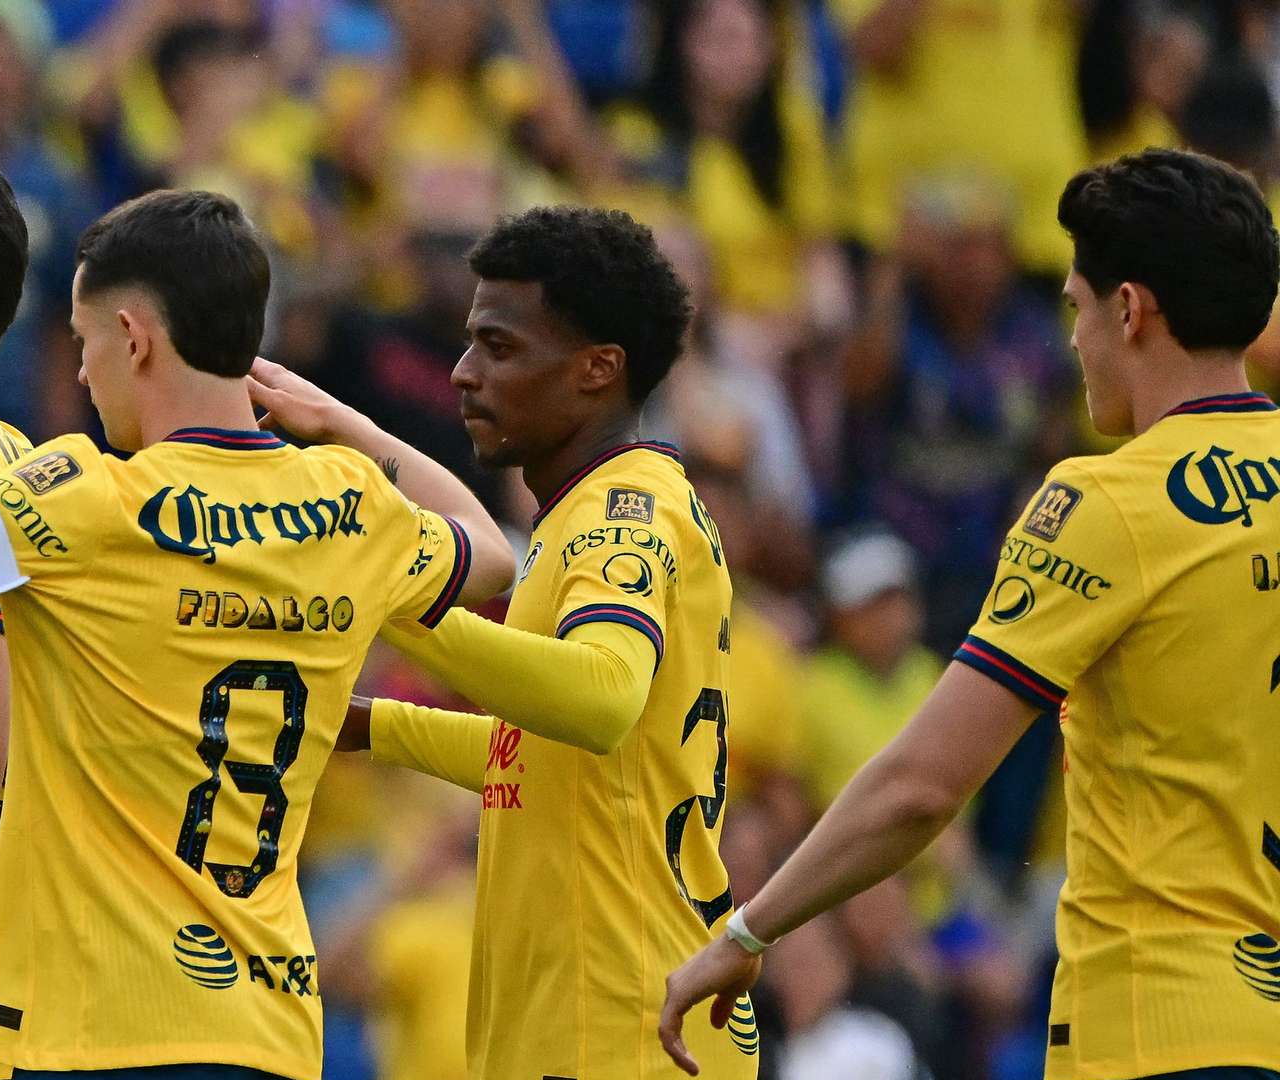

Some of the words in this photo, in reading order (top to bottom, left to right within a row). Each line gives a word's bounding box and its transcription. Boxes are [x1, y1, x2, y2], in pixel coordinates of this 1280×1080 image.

[137, 484, 368, 565] Corona
[176, 588, 354, 633] FIDALGO
[177, 660, 309, 899] 8
